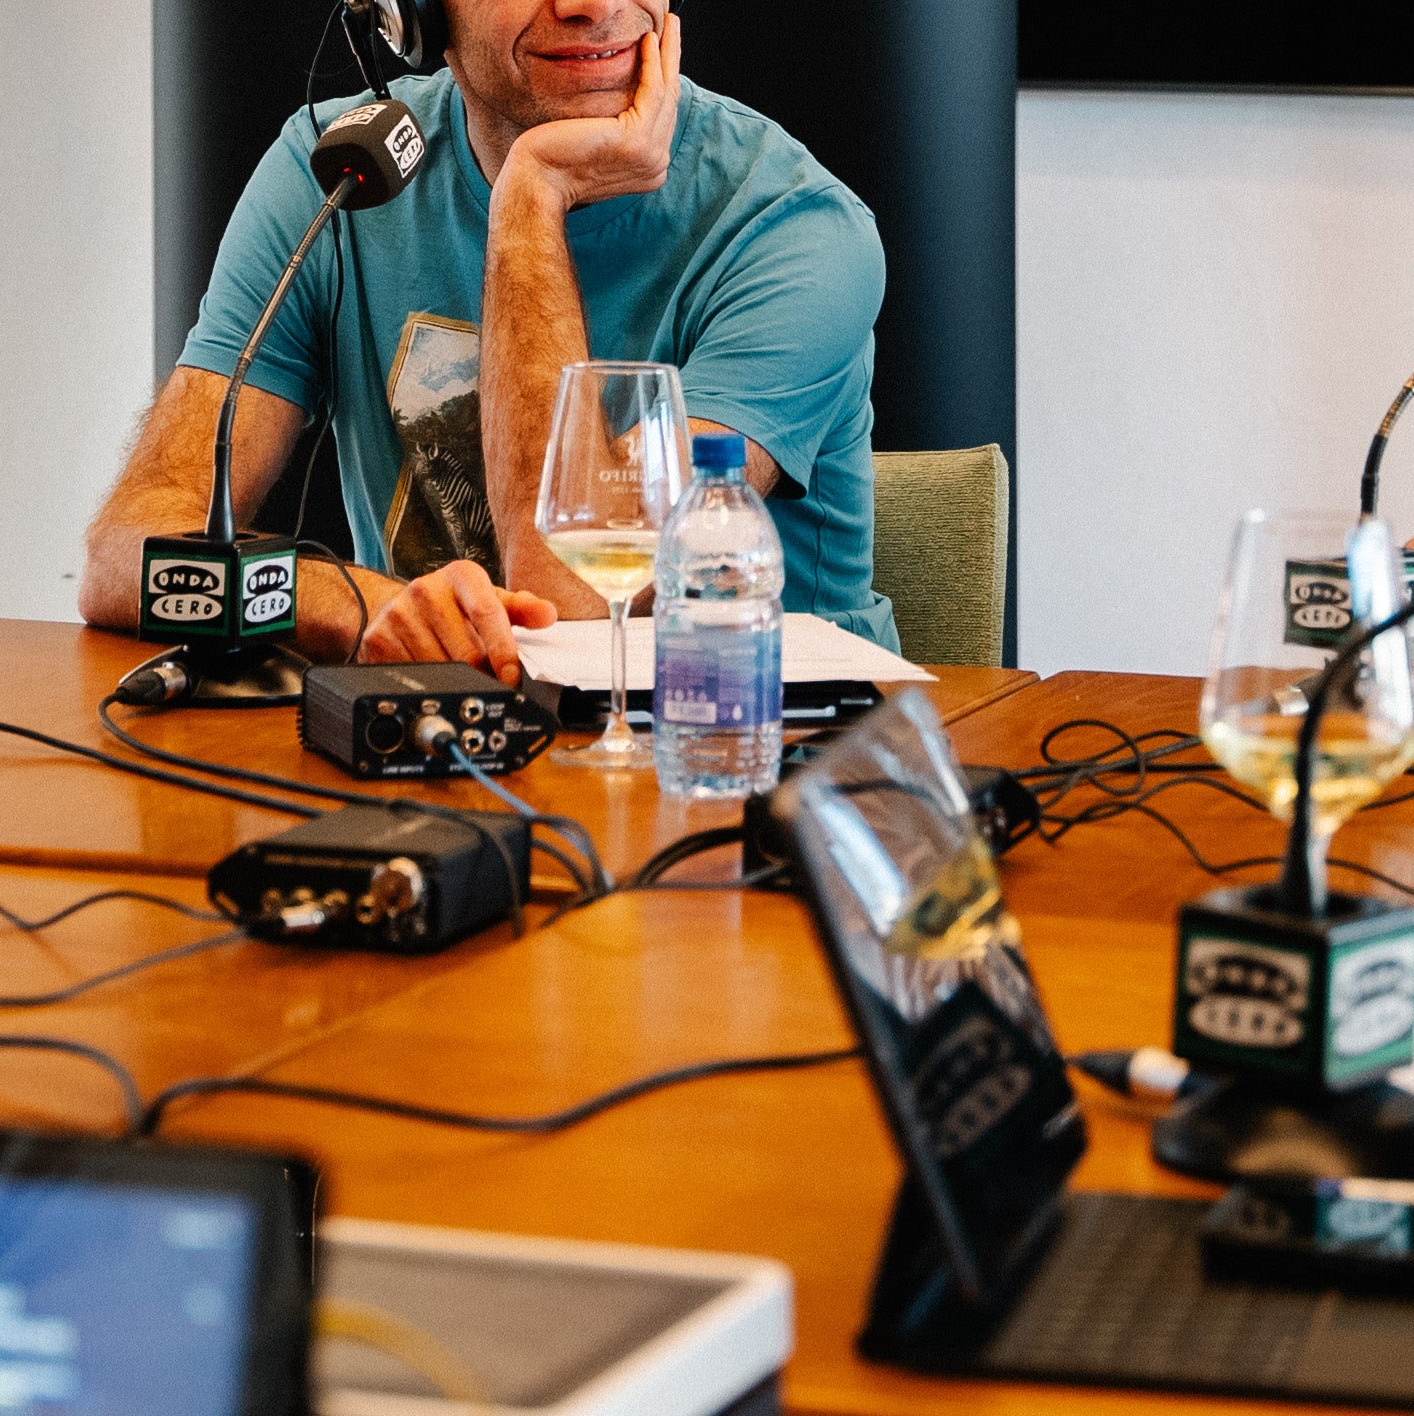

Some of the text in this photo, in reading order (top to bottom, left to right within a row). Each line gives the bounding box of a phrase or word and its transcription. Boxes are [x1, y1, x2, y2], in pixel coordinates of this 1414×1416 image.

[393, 125, 413, 151] ONDA
[158, 572, 214, 588] ONDA
[249, 570, 286, 590] ONDA
[161, 599, 213, 616] CERO
[251, 598, 285, 616] CERO
